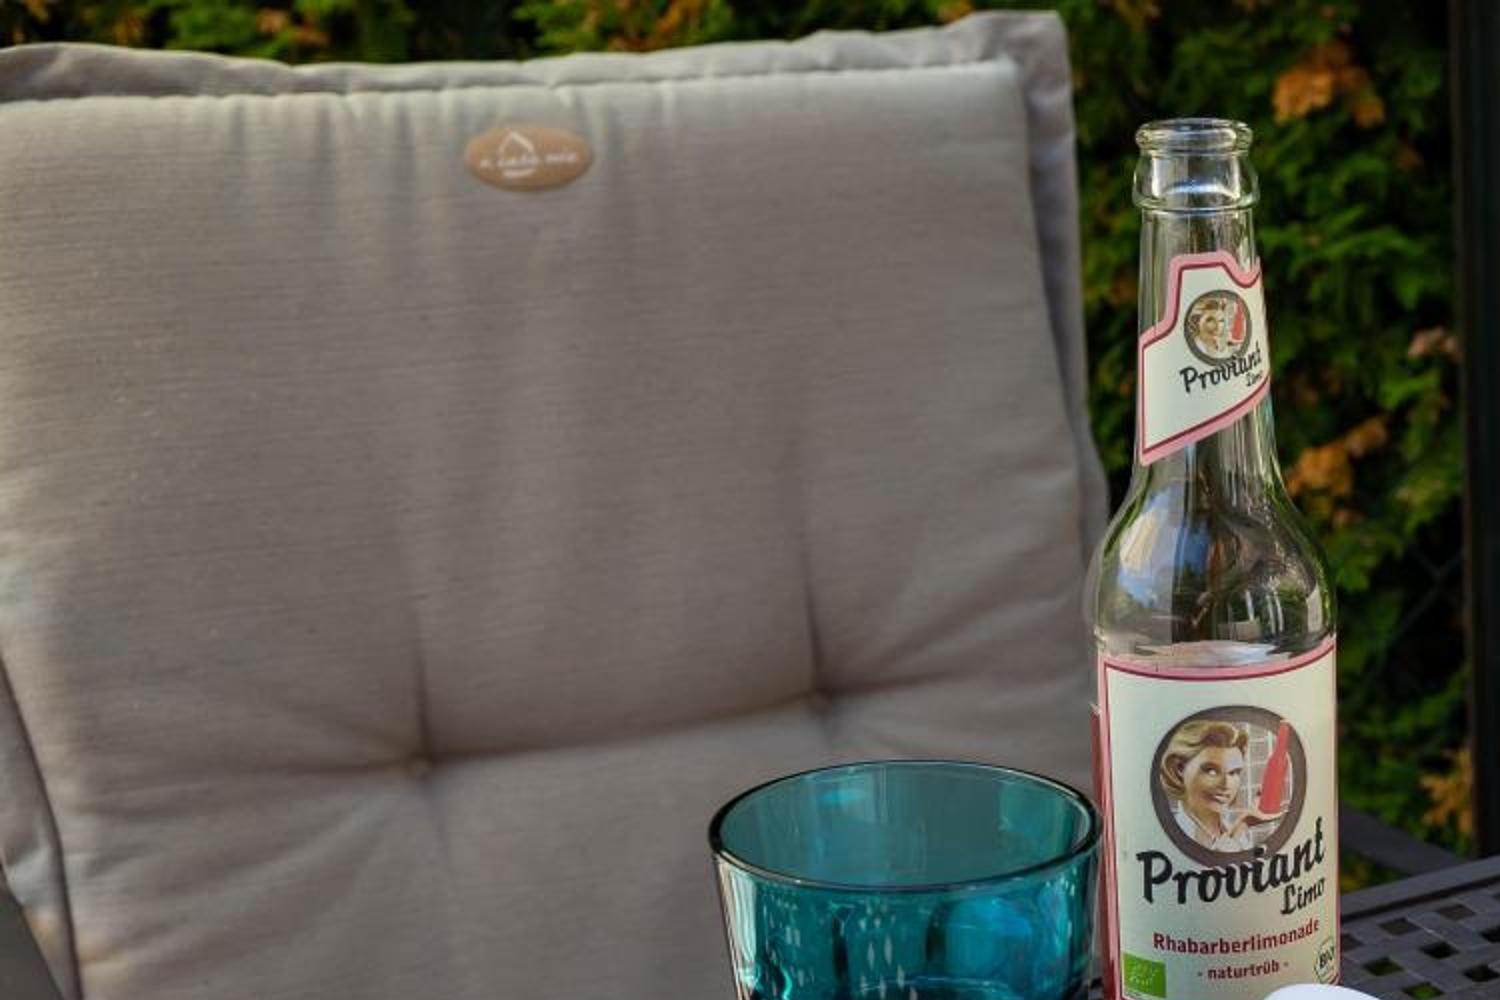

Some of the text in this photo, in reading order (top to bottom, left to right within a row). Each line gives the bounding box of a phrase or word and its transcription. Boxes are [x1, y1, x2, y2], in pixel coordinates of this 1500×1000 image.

[1179, 341, 1261, 394] Proviant
[1136, 816, 1326, 905] Proviant
[1280, 877, 1326, 916] Limo
[1152, 917, 1319, 954] Rhabarberlimonade
[1207, 960, 1280, 980] naturtrüb
